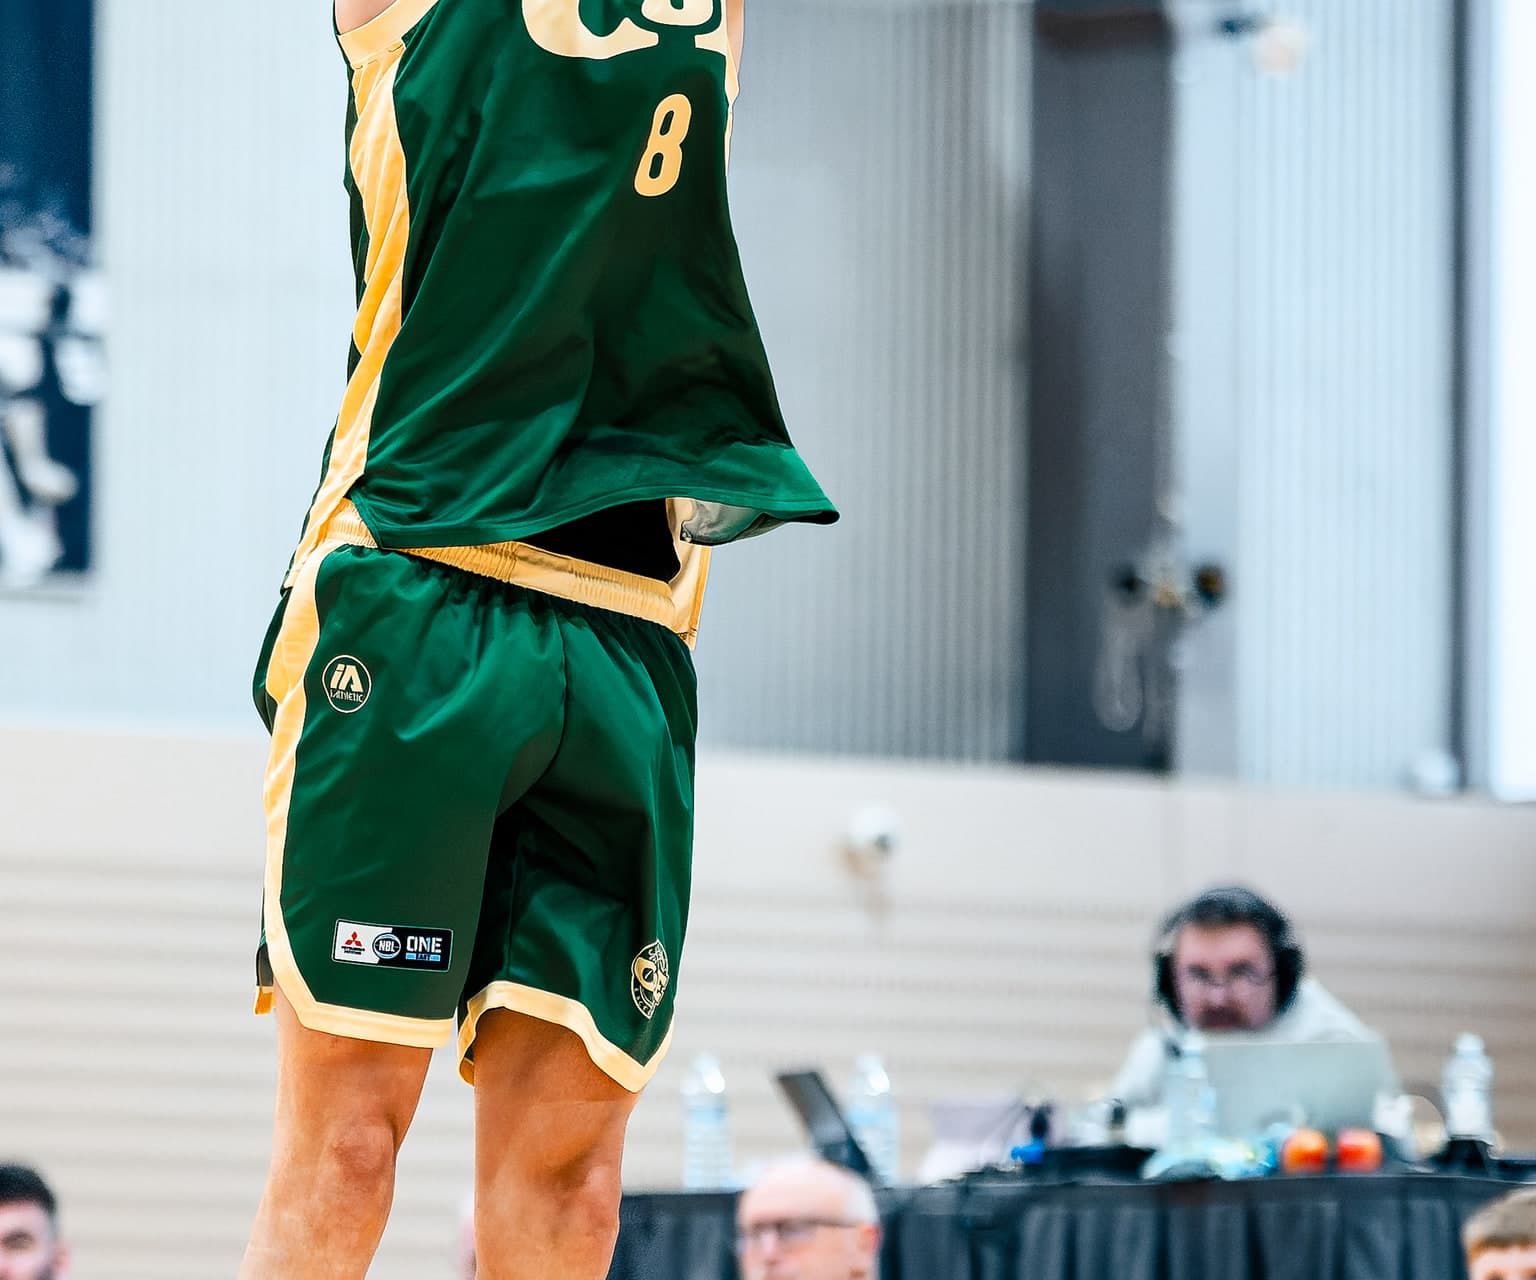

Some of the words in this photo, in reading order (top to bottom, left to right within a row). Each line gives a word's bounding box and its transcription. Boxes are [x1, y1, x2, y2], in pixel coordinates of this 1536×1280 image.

[633, 93, 693, 198] 8
[378, 939, 396, 953] NBL
[405, 935, 444, 954] ONE
